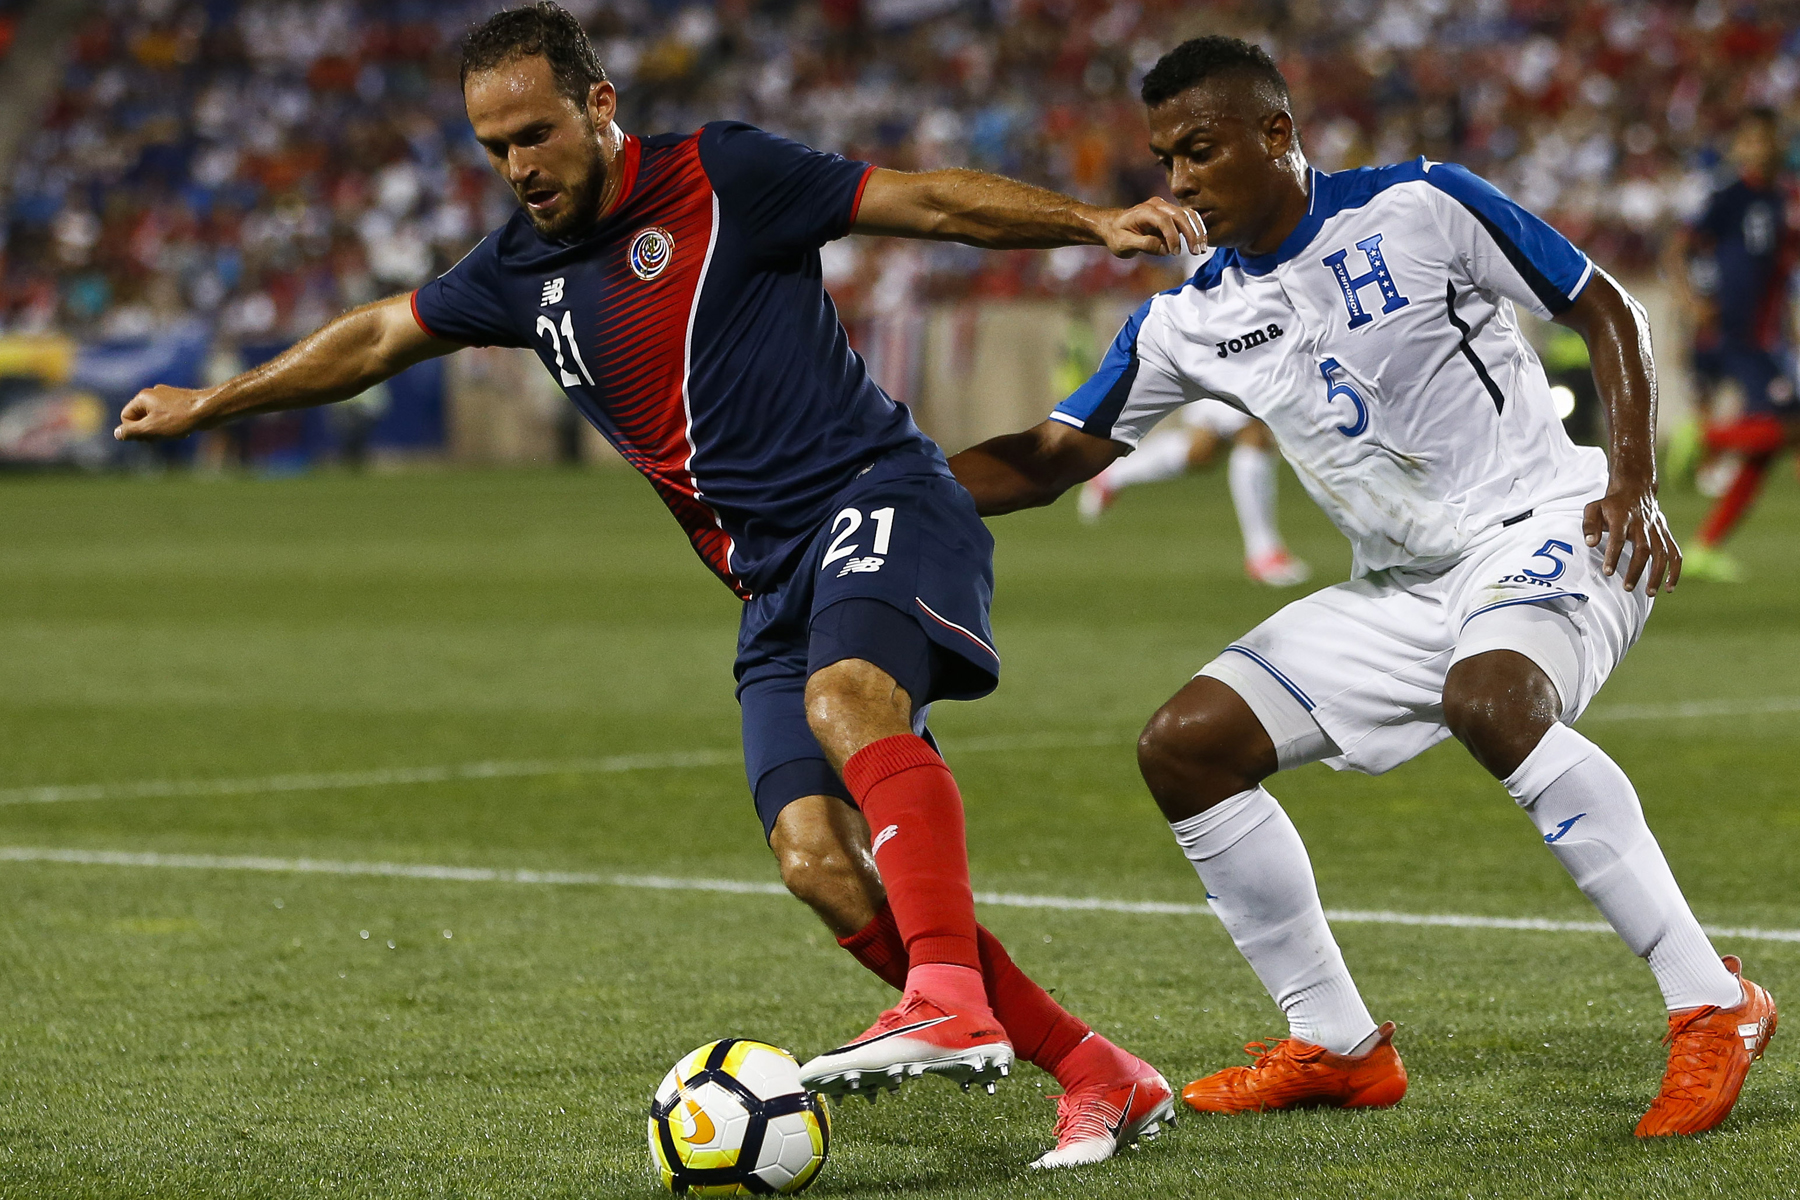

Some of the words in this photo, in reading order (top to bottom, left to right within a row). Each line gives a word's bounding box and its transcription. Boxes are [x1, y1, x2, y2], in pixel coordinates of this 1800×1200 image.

[1321, 232, 1411, 331] H
[1334, 263, 1360, 316] HONDURAS
[536, 310, 595, 387] 21
[1319, 357, 1369, 437] 5
[821, 507, 895, 570] 21
[1521, 538, 1573, 582] 5
